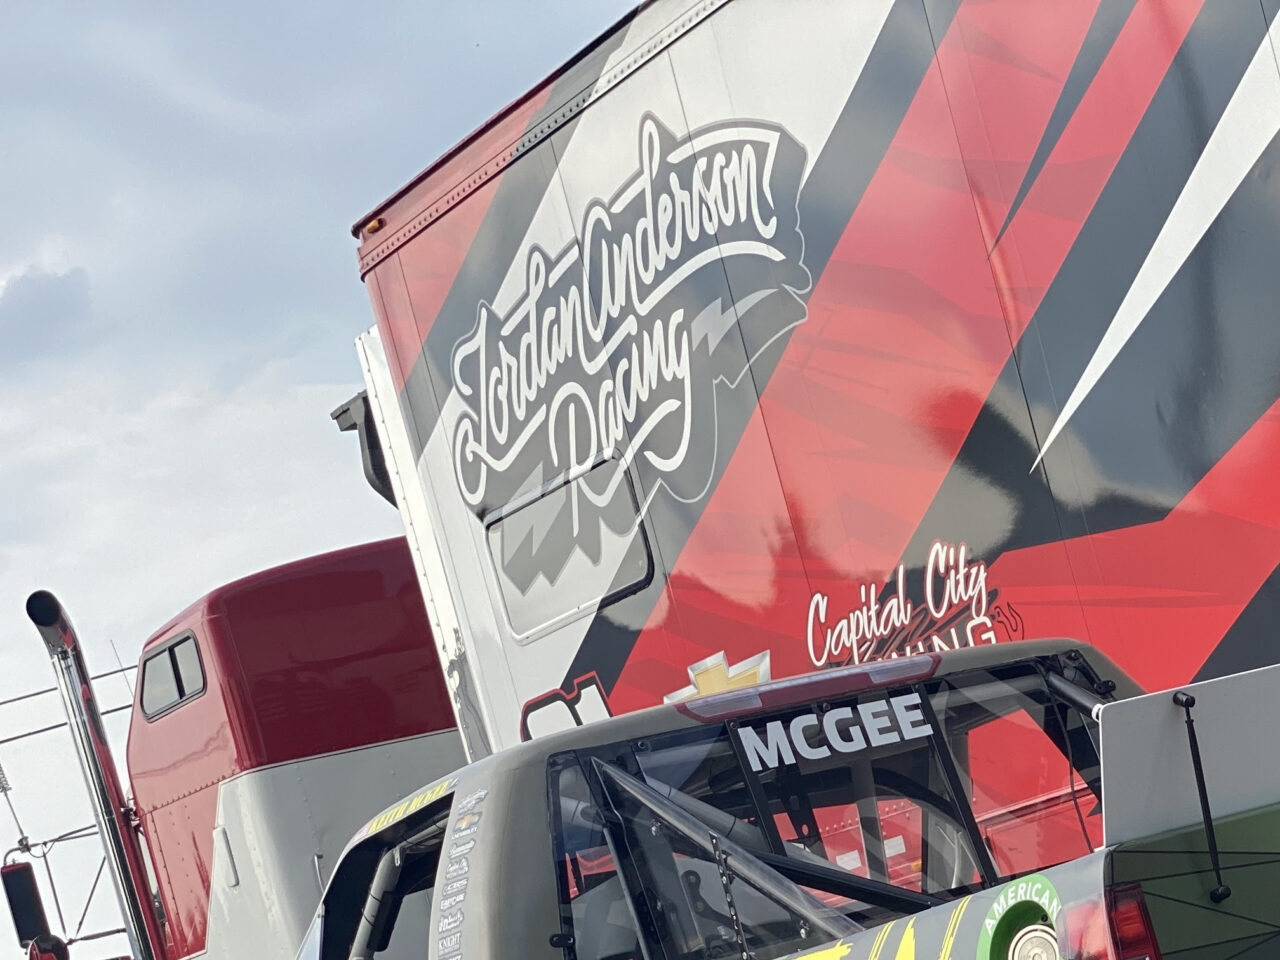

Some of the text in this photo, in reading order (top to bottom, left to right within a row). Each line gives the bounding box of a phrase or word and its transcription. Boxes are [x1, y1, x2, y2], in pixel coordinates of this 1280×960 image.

[453, 118, 787, 505] Jordan Anderson
[549, 308, 692, 538] Racing
[807, 562, 911, 667] Capital
[925, 541, 988, 620] City
[737, 692, 934, 772] MCGEE
[984, 882, 1063, 937] AMERICAN
